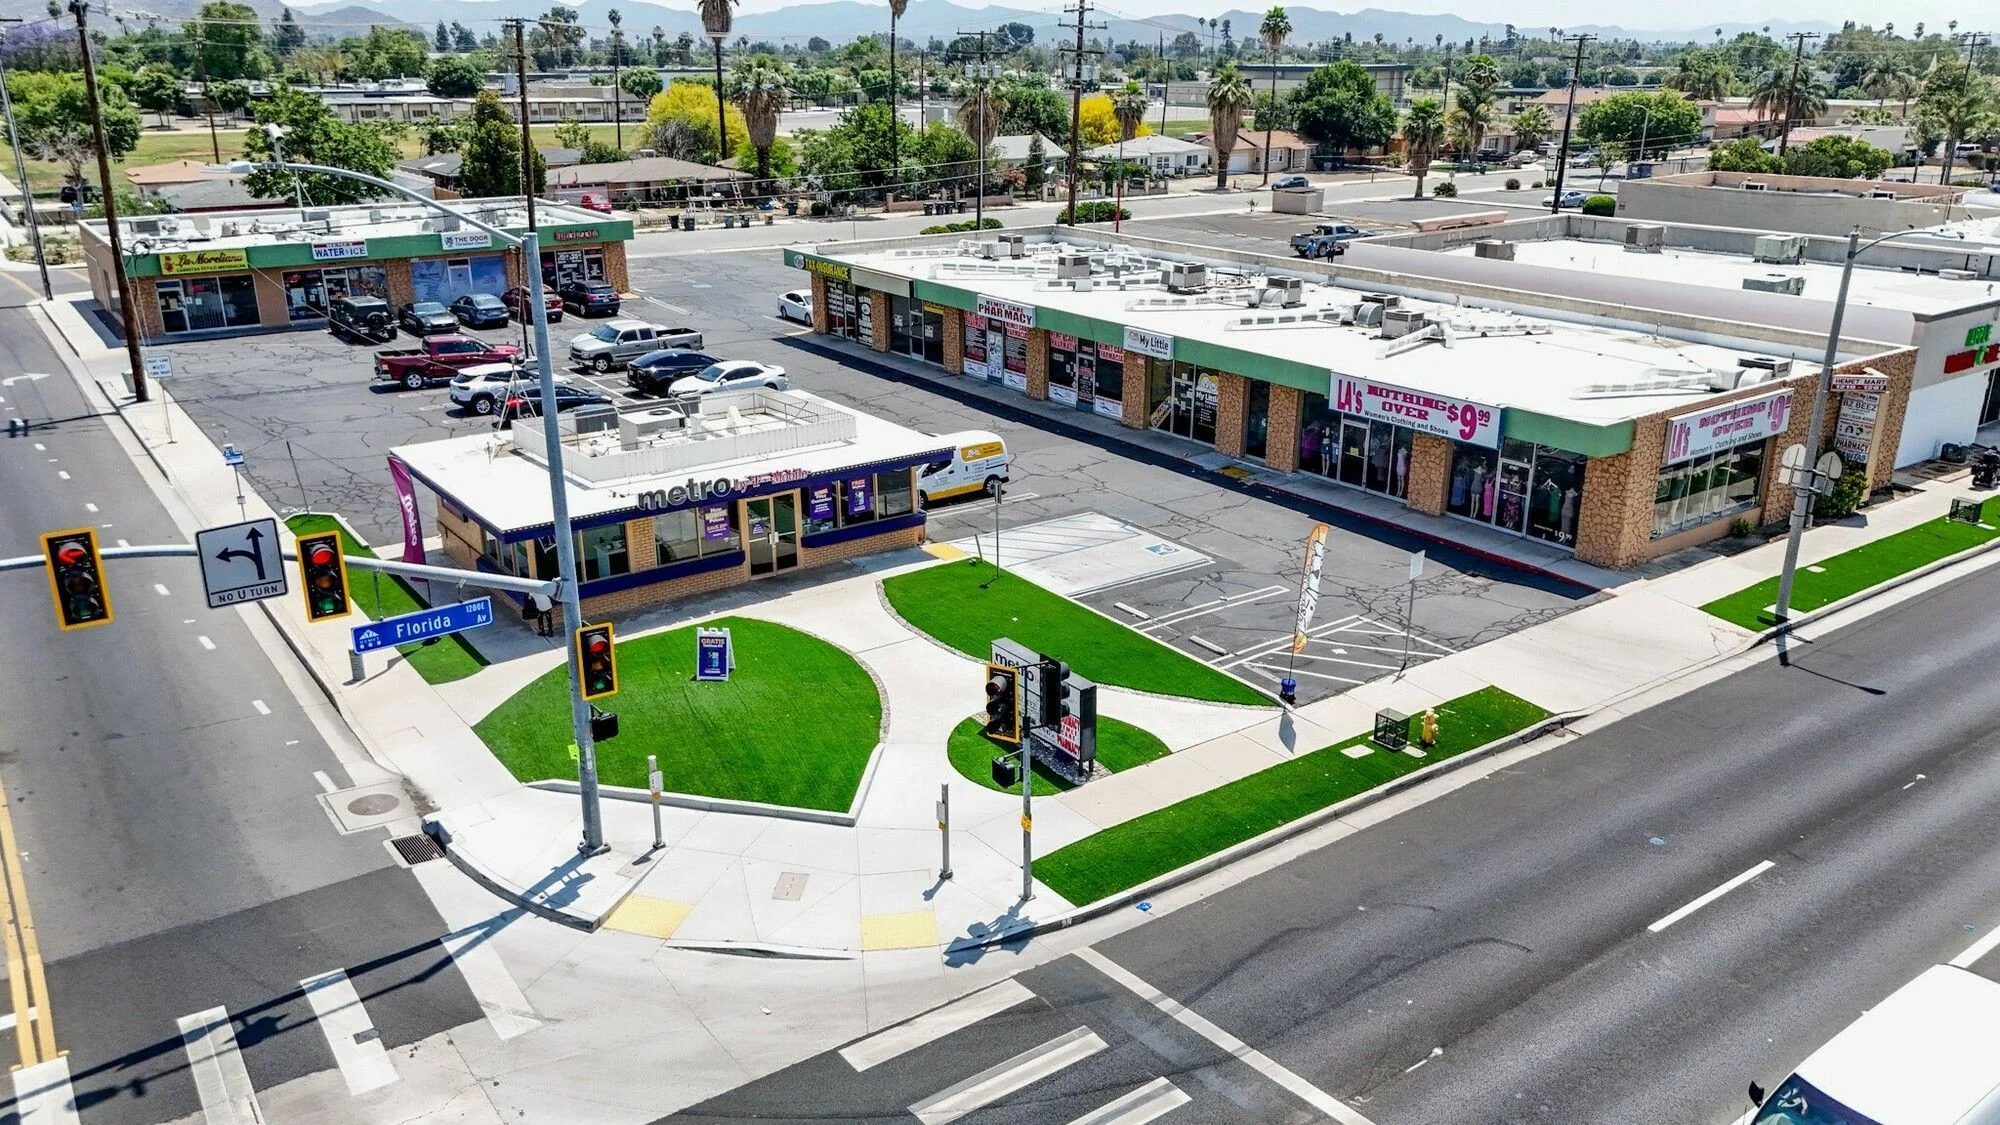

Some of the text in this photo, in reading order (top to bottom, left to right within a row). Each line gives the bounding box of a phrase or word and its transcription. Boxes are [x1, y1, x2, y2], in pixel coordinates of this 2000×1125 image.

[315, 249, 345, 258] WATER
[978, 303, 1033, 325] PHARMACY
[1140, 334, 1149, 347] My
[1151, 335, 1169, 351] Little
[1337, 379, 1362, 415] LA's
[1367, 384, 1447, 412] NOTHING
[1381, 402, 1429, 421] OVER
[1699, 402, 1766, 428] NOTHING
[1364, 410, 1449, 435] Women's Clothing and Shoes
[1712, 418, 1754, 438] OVER
[1836, 438, 1869, 453] PHARMACY
[637, 467, 808, 511] metro by T-Mobile
[401, 493, 418, 547] metro
[219, 585, 278, 603] NO U TURN
[466, 601, 485, 613] 1200E
[396, 614, 487, 638] Florida Av
